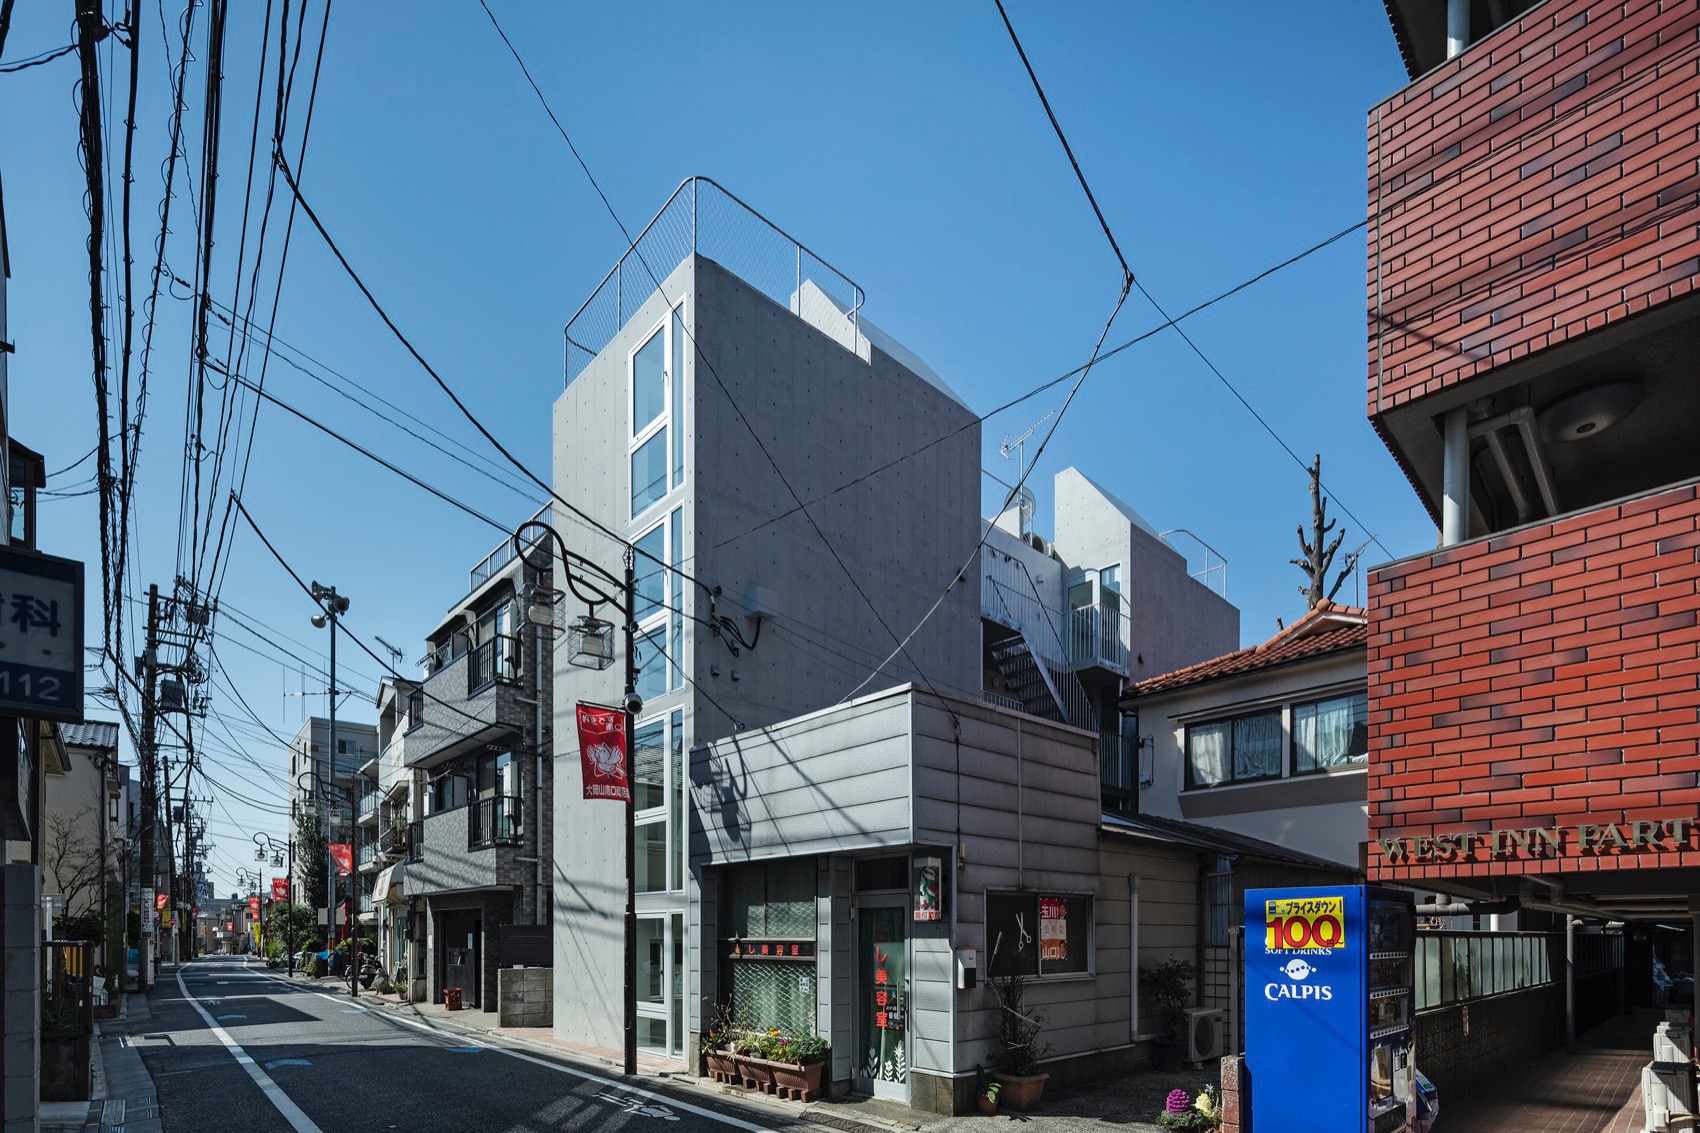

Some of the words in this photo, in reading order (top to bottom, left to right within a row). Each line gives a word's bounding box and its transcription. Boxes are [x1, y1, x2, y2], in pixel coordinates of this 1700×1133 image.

[0, 593, 61, 637] 科
[1375, 831, 1479, 859] WEST
[1489, 825, 1563, 856] INN
[1575, 817, 1694, 849] PART
[1293, 947, 1332, 955] DRINKS
[1265, 983, 1332, 1001] CALPIS
